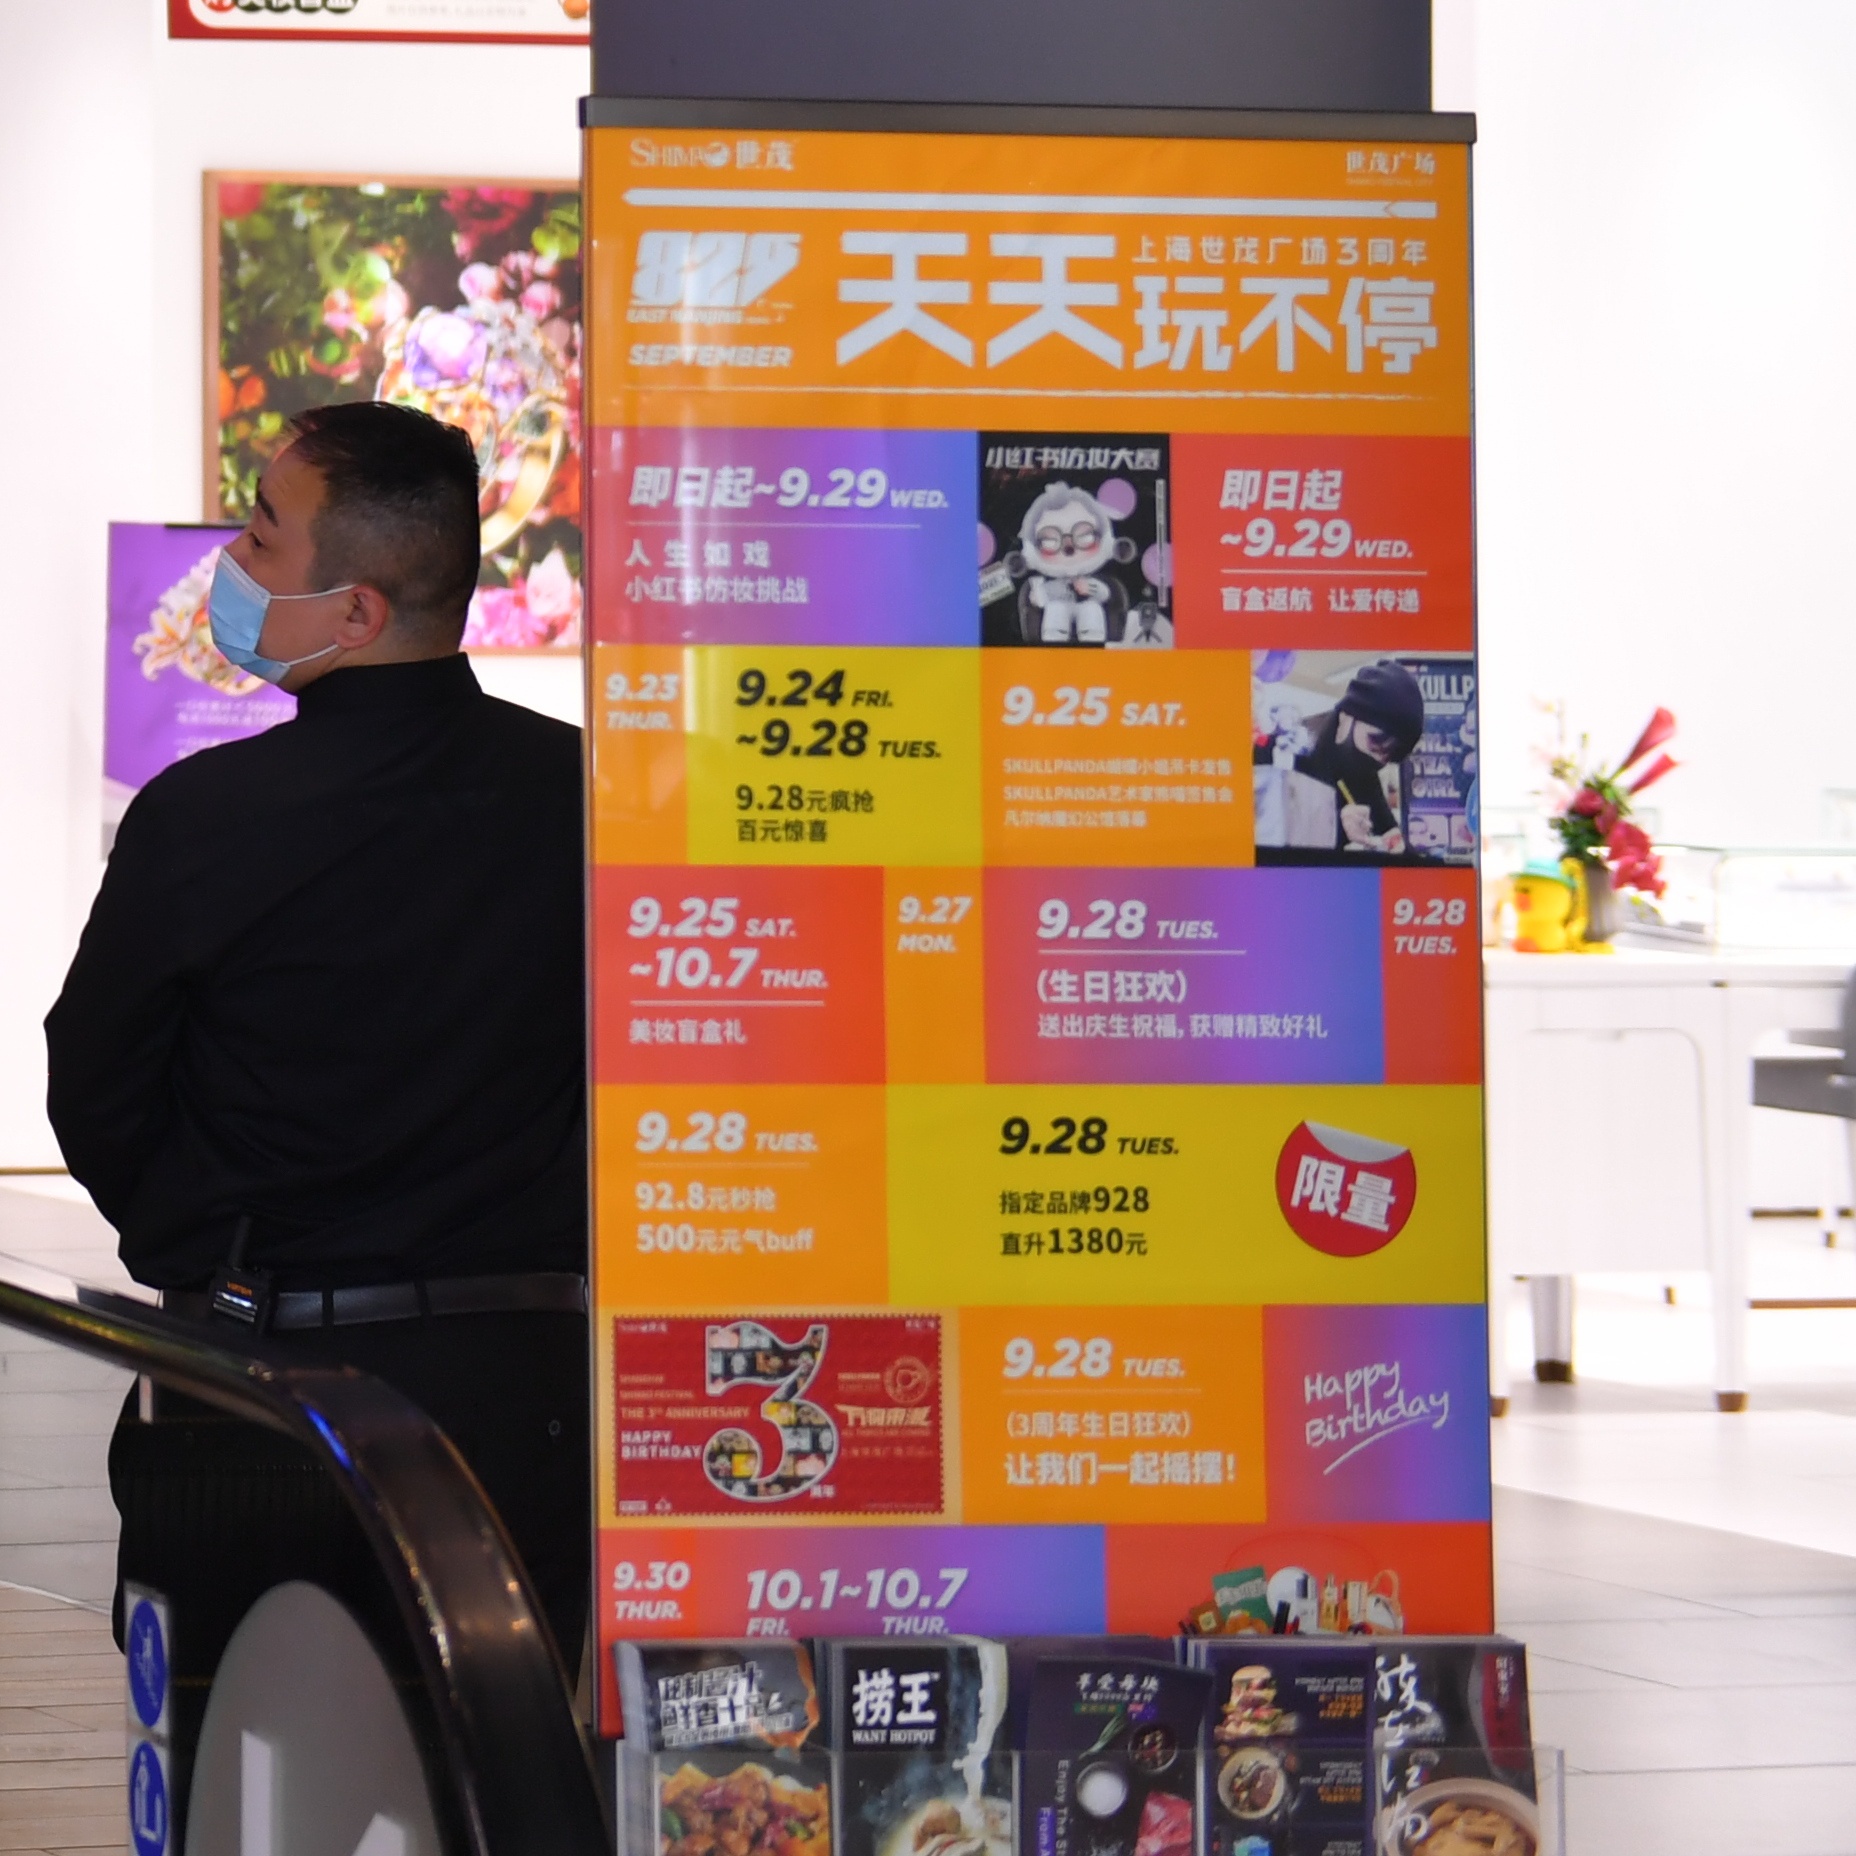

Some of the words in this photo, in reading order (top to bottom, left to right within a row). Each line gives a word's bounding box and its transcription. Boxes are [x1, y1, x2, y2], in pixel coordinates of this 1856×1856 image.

[1346, 152, 1435, 174] 世茂广场
[1132, 235, 1428, 266] 上海世茂广场3周年
[629, 344, 795, 368] SEPTEMBER
[985, 447, 1161, 470] 小红书仿妆大赛
[890, 489, 949, 509] WED.
[1219, 469, 1344, 511] 即日起
[1220, 518, 1352, 559] ~9.29
[1354, 539, 1413, 559] WED.
[625, 576, 809, 604] 小红书仿妆挑战
[1221, 587, 1313, 612] 盲盒返航
[1328, 587, 1420, 613] 让爱传递
[605, 674, 680, 702] 9.23
[735, 669, 846, 707] 9.24
[852, 690, 894, 708] FRI.
[606, 711, 675, 731] THUR.
[1002, 687, 1111, 727] 9.25
[1121, 704, 1186, 727] SAT.
[736, 719, 869, 758] ~9.28
[878, 741, 942, 759] TUES.
[735, 785, 875, 813] 9.28元疯抢
[736, 820, 828, 843] 百元惊喜
[628, 897, 739, 937] 9.25
[744, 918, 797, 937] SAT.
[898, 896, 973, 923] 9.27
[1037, 899, 1147, 939] 9.28
[1157, 921, 1219, 939] TUES.
[1393, 899, 1466, 925] 9.28
[897, 935, 957, 952] MON.
[1394, 936, 1458, 954] TUES.
[629, 947, 759, 988] ~10.7
[760, 969, 829, 988] THUR.
[629, 1017, 747, 1043] 美妆盲盒礼
[635, 1112, 747, 1152] 9.28
[755, 1133, 818, 1152] TUES.
[999, 1116, 1108, 1155] 9.28
[1117, 1137, 1180, 1155] TUES.
[635, 1182, 777, 1212] 92.8元秒抢
[999, 1186, 1150, 1214] 指定品牌928
[1290, 1154, 1397, 1233] 限量
[636, 1224, 815, 1253] 500元元气buff
[1000, 1227, 1148, 1256] 直升1380元
[1002, 1337, 1112, 1378] 9.28
[1123, 1358, 1186, 1378] TUES.
[1304, 1360, 1402, 1412] Happy
[1305, 1390, 1451, 1447] Birthday
[621, 1430, 672, 1444] HAPPY
[621, 1445, 703, 1460] BIRTHDAY
[613, 1561, 691, 1591] 9.30
[746, 1568, 969, 1612] 10.1~10.7
[615, 1601, 683, 1621] THUR.
[746, 1617, 791, 1637] FRI.
[882, 1616, 950, 1636] THUR.
[851, 1667, 938, 1727] 捞王
